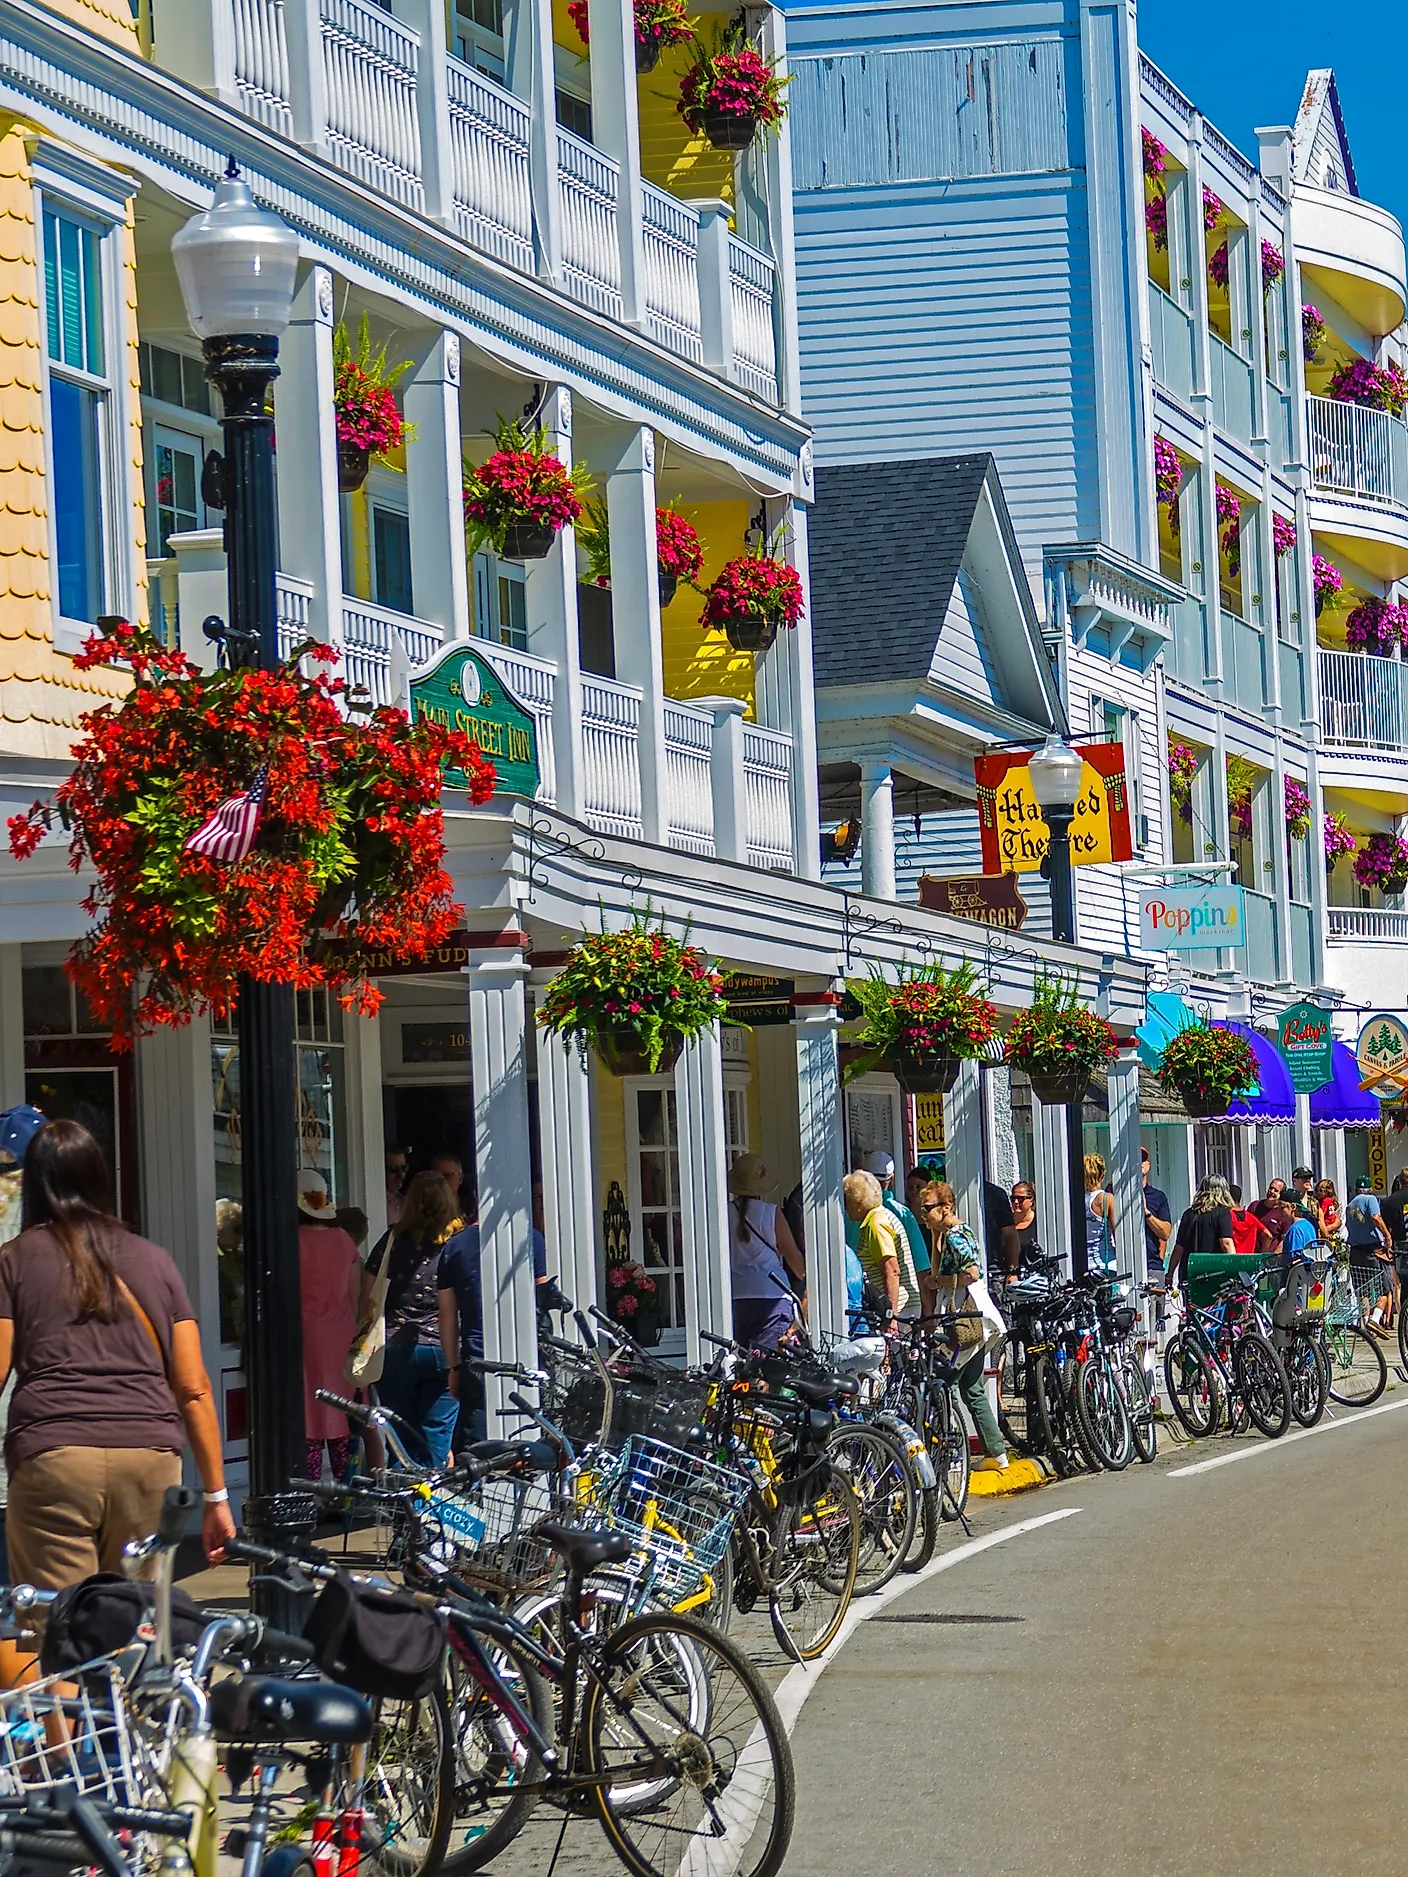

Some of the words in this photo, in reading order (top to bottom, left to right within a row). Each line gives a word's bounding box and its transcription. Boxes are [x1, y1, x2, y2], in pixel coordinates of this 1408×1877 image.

[455, 709, 503, 756] STREET
[506, 722, 531, 762] INN
[999, 785, 1101, 824] Haed
[1001, 828, 1099, 860] There
[1145, 900, 1237, 936] Poppins
[421, 947, 467, 965] FUD
[726, 1006, 772, 1018] ephew's
[1282, 1018, 1328, 1047] Betty's
[1371, 1134, 1384, 1190] HOPS
